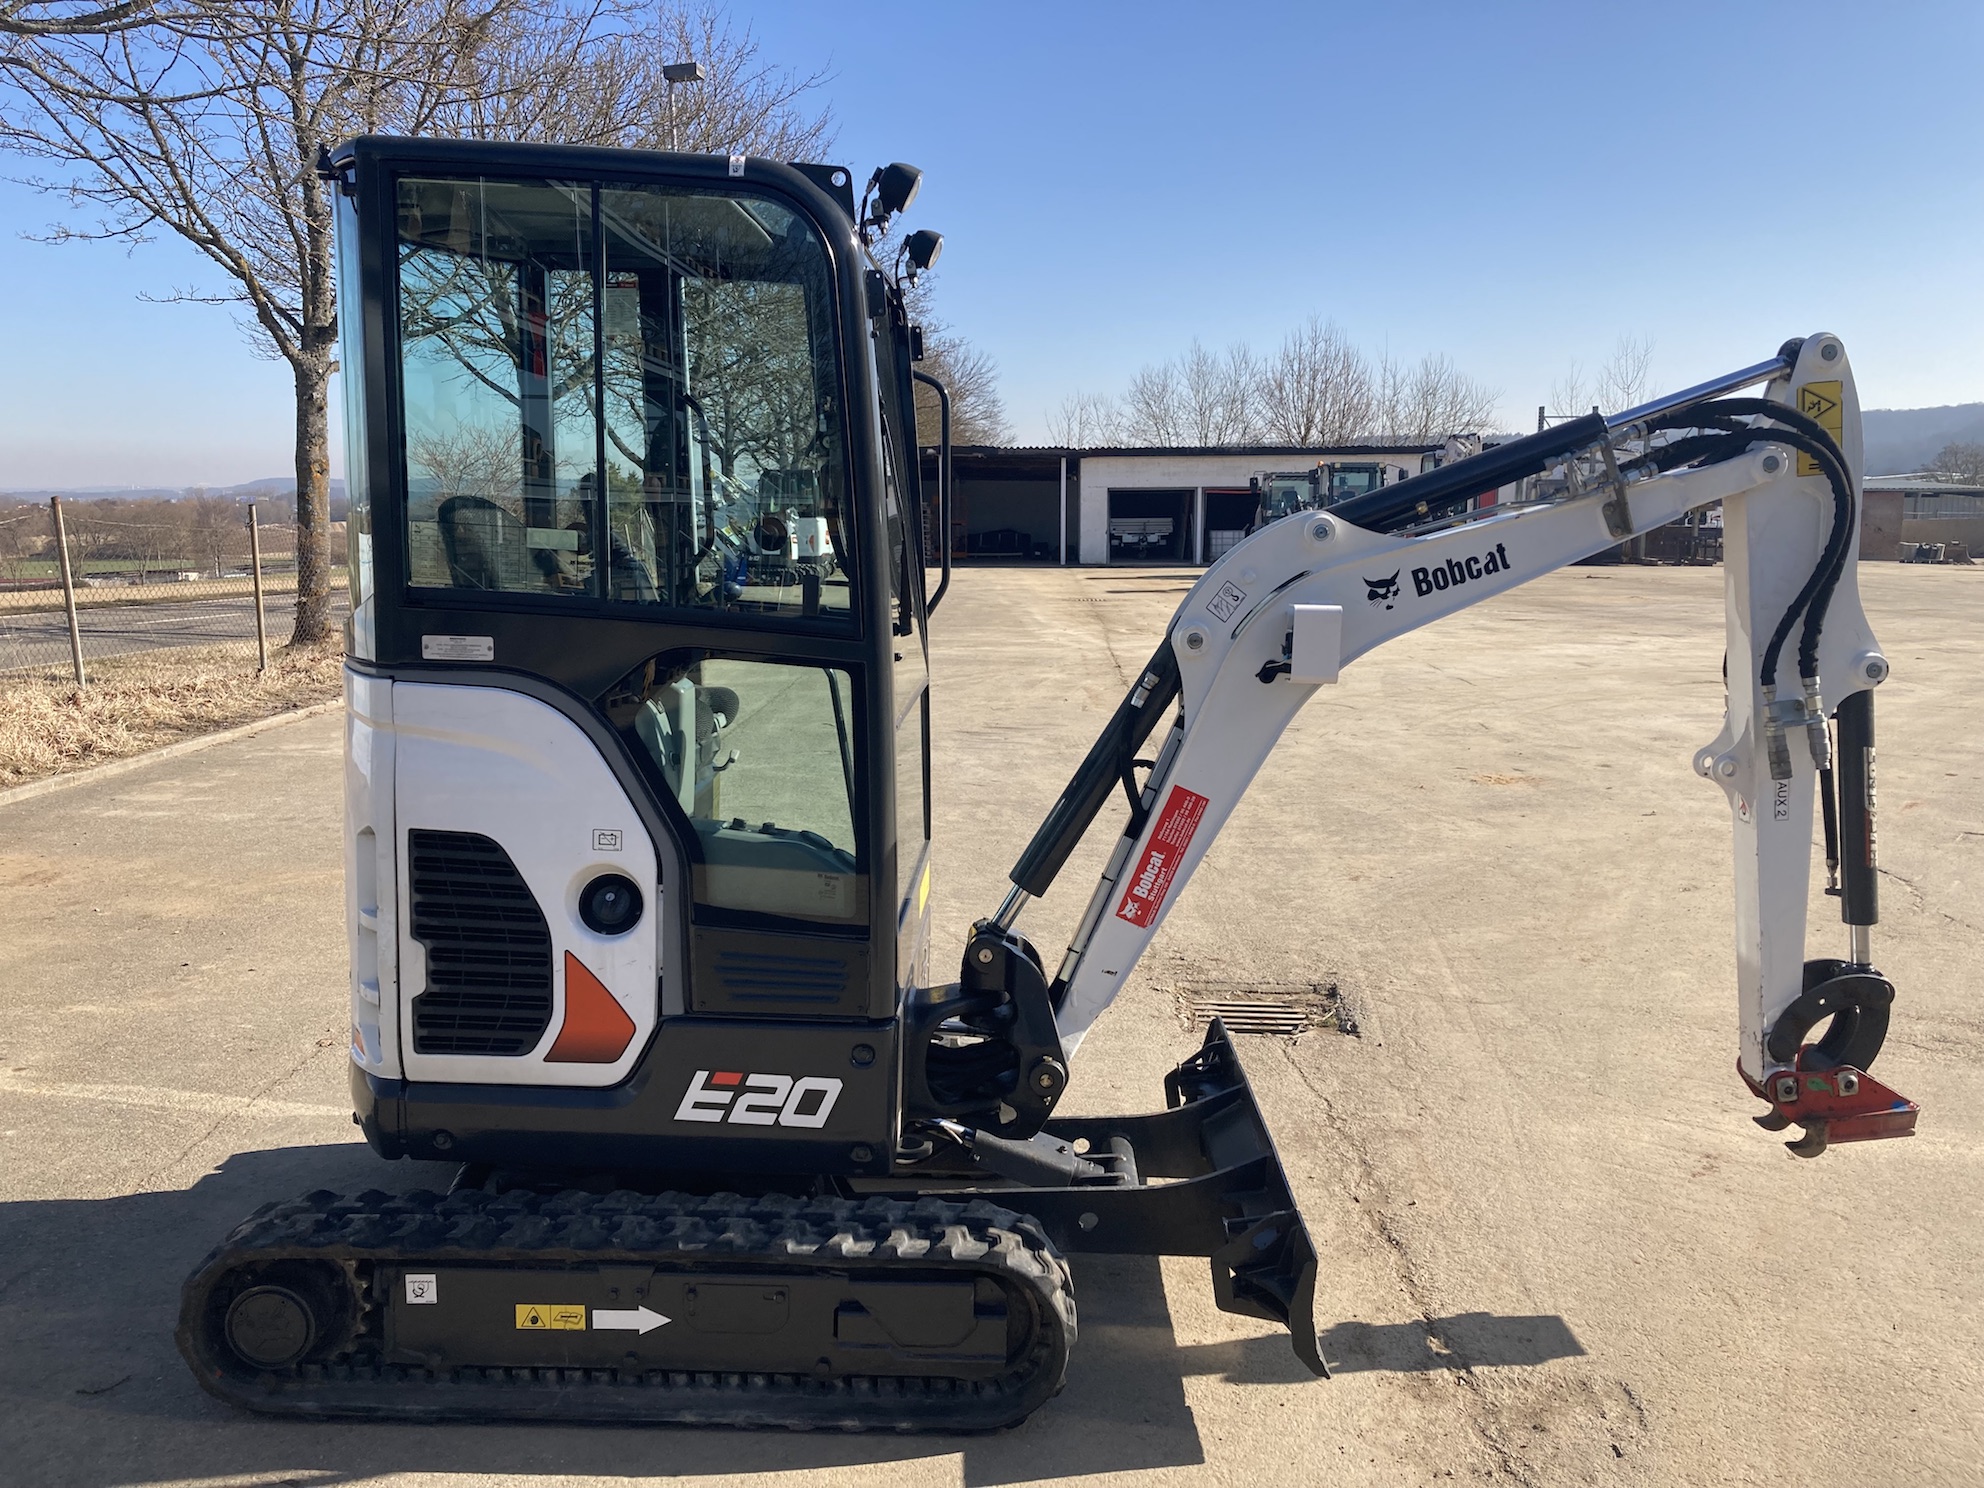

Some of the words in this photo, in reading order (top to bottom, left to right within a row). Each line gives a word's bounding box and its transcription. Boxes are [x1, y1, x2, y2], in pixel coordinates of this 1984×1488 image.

[1411, 543, 1510, 597] Bobcat
[1777, 782, 1788, 807] AUX
[1779, 809, 1788, 817] 2
[1133, 850, 1165, 898] Bobcat
[1148, 867, 1167, 901] Stuttgart
[673, 1070, 843, 1129] E20
